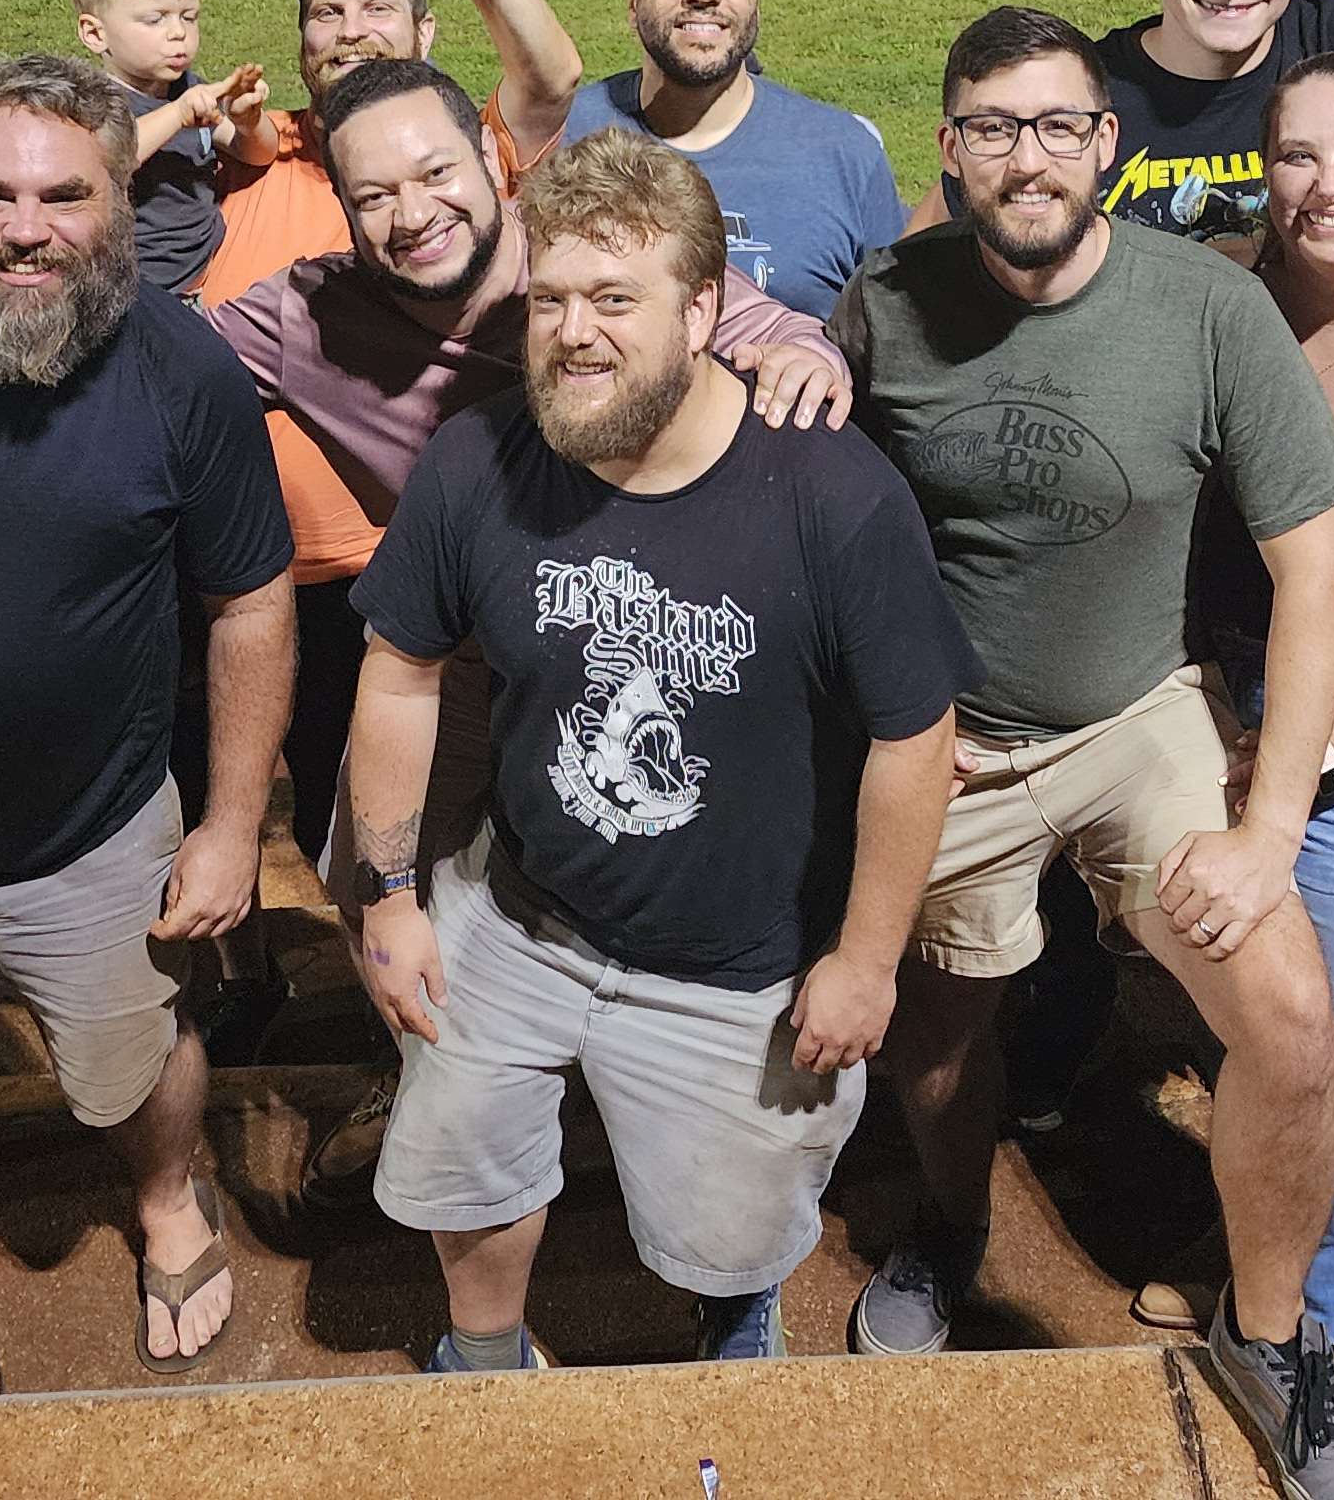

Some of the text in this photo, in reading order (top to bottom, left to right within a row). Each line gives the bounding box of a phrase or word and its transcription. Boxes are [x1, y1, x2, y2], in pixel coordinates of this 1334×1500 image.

[1102, 146, 1264, 214] METALLI
[995, 407, 1085, 458] Bass
[997, 448, 1062, 488] Pro
[997, 481, 1110, 534] Shops
[594, 555, 658, 598] The
[535, 559, 756, 658] Bastard
